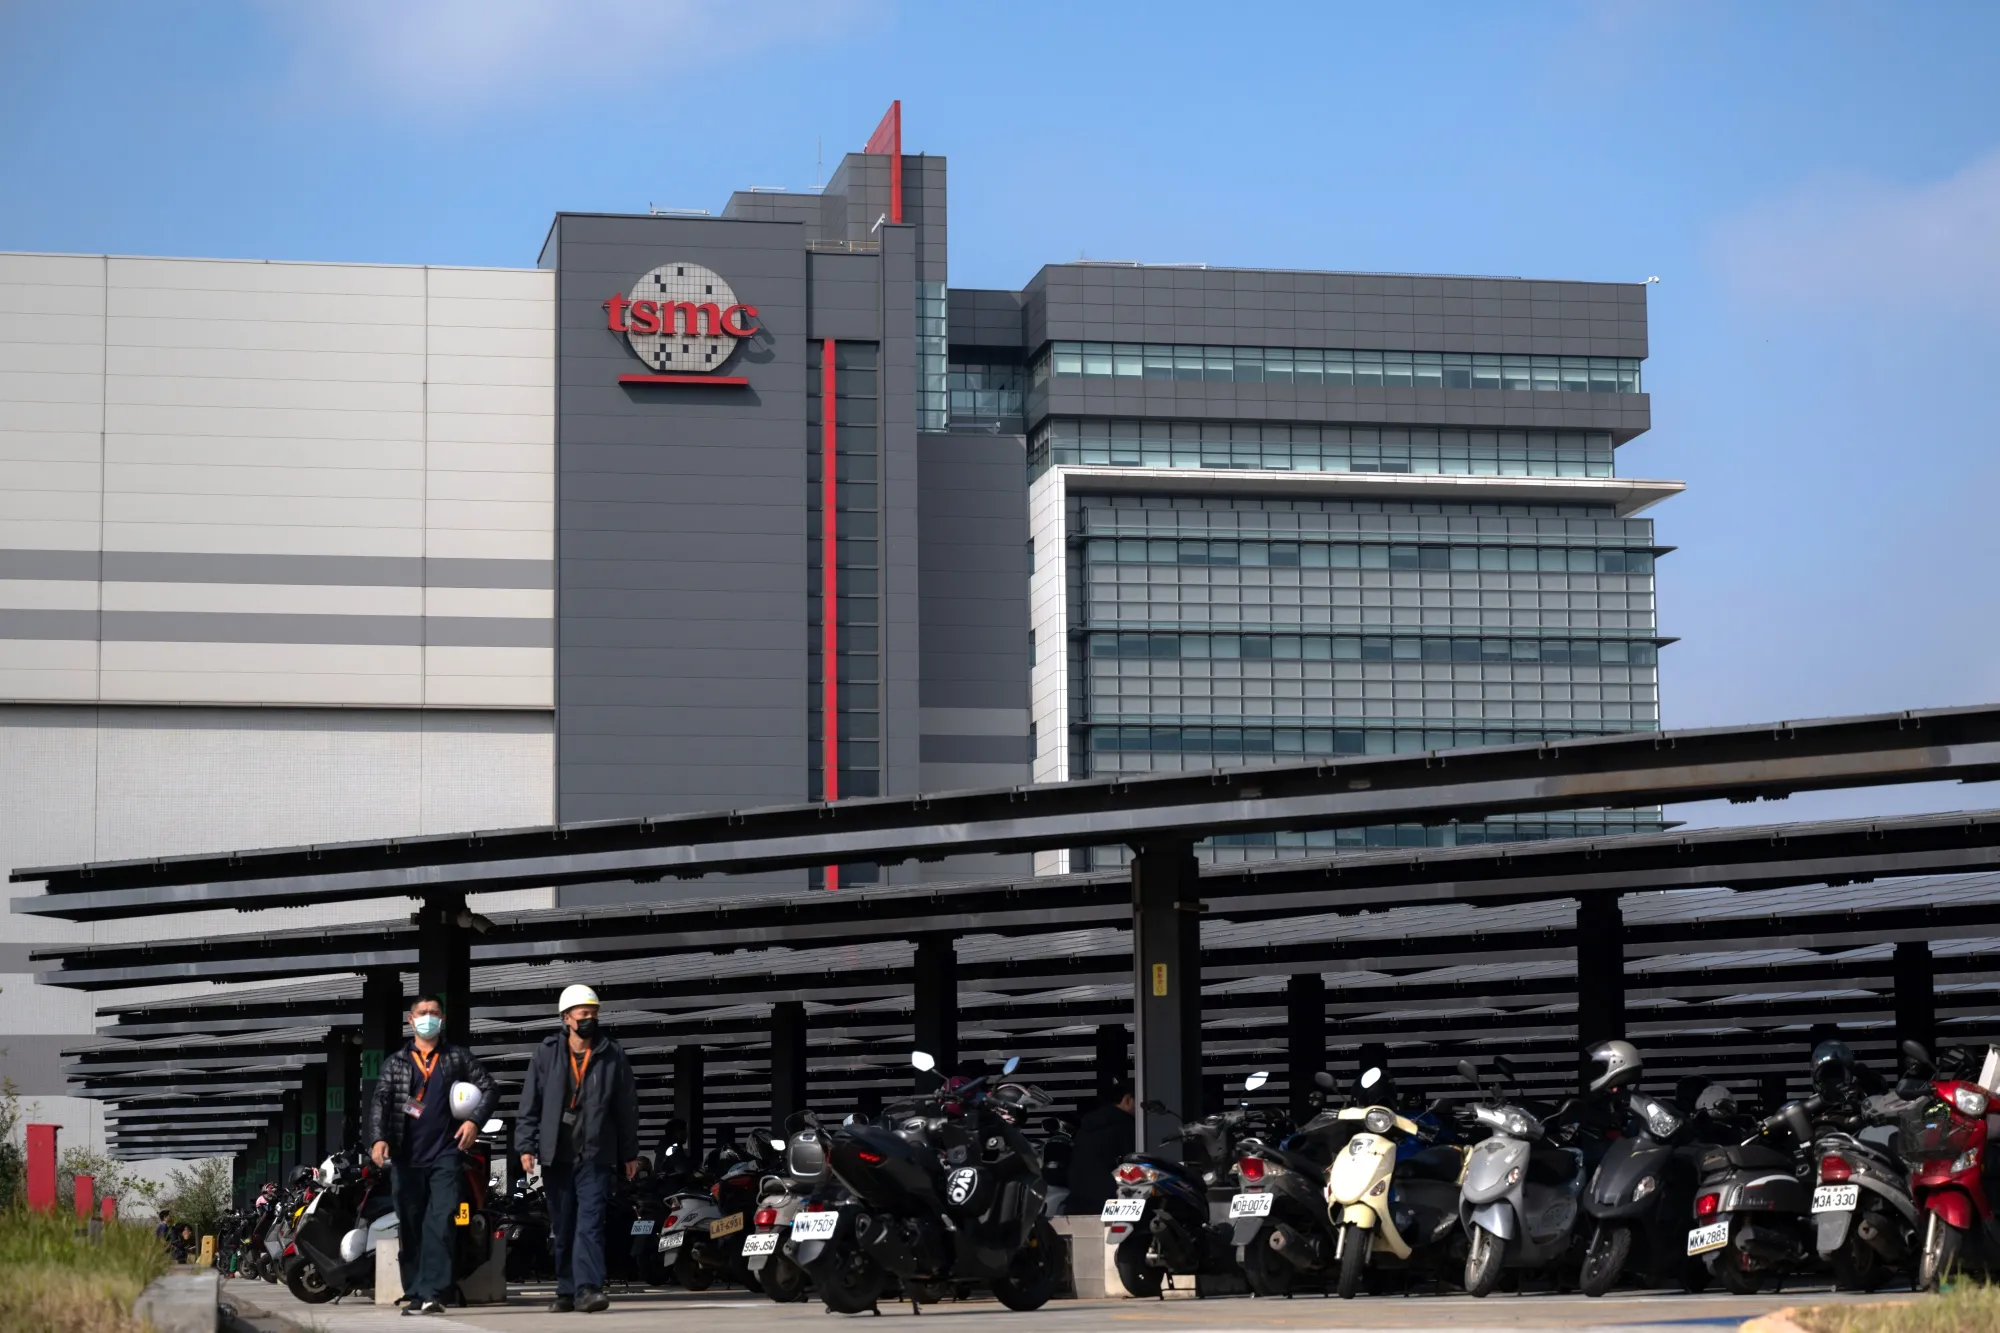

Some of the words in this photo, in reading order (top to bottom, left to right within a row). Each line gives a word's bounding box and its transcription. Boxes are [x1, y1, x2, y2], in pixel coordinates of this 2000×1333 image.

[602, 292, 758, 336] tsmc
[366, 1052, 380, 1077] 11
[329, 1090, 341, 1109] 10
[304, 1115, 315, 1133] 9
[285, 1135, 292, 1149] 8
[952, 1169, 974, 1203] evo
